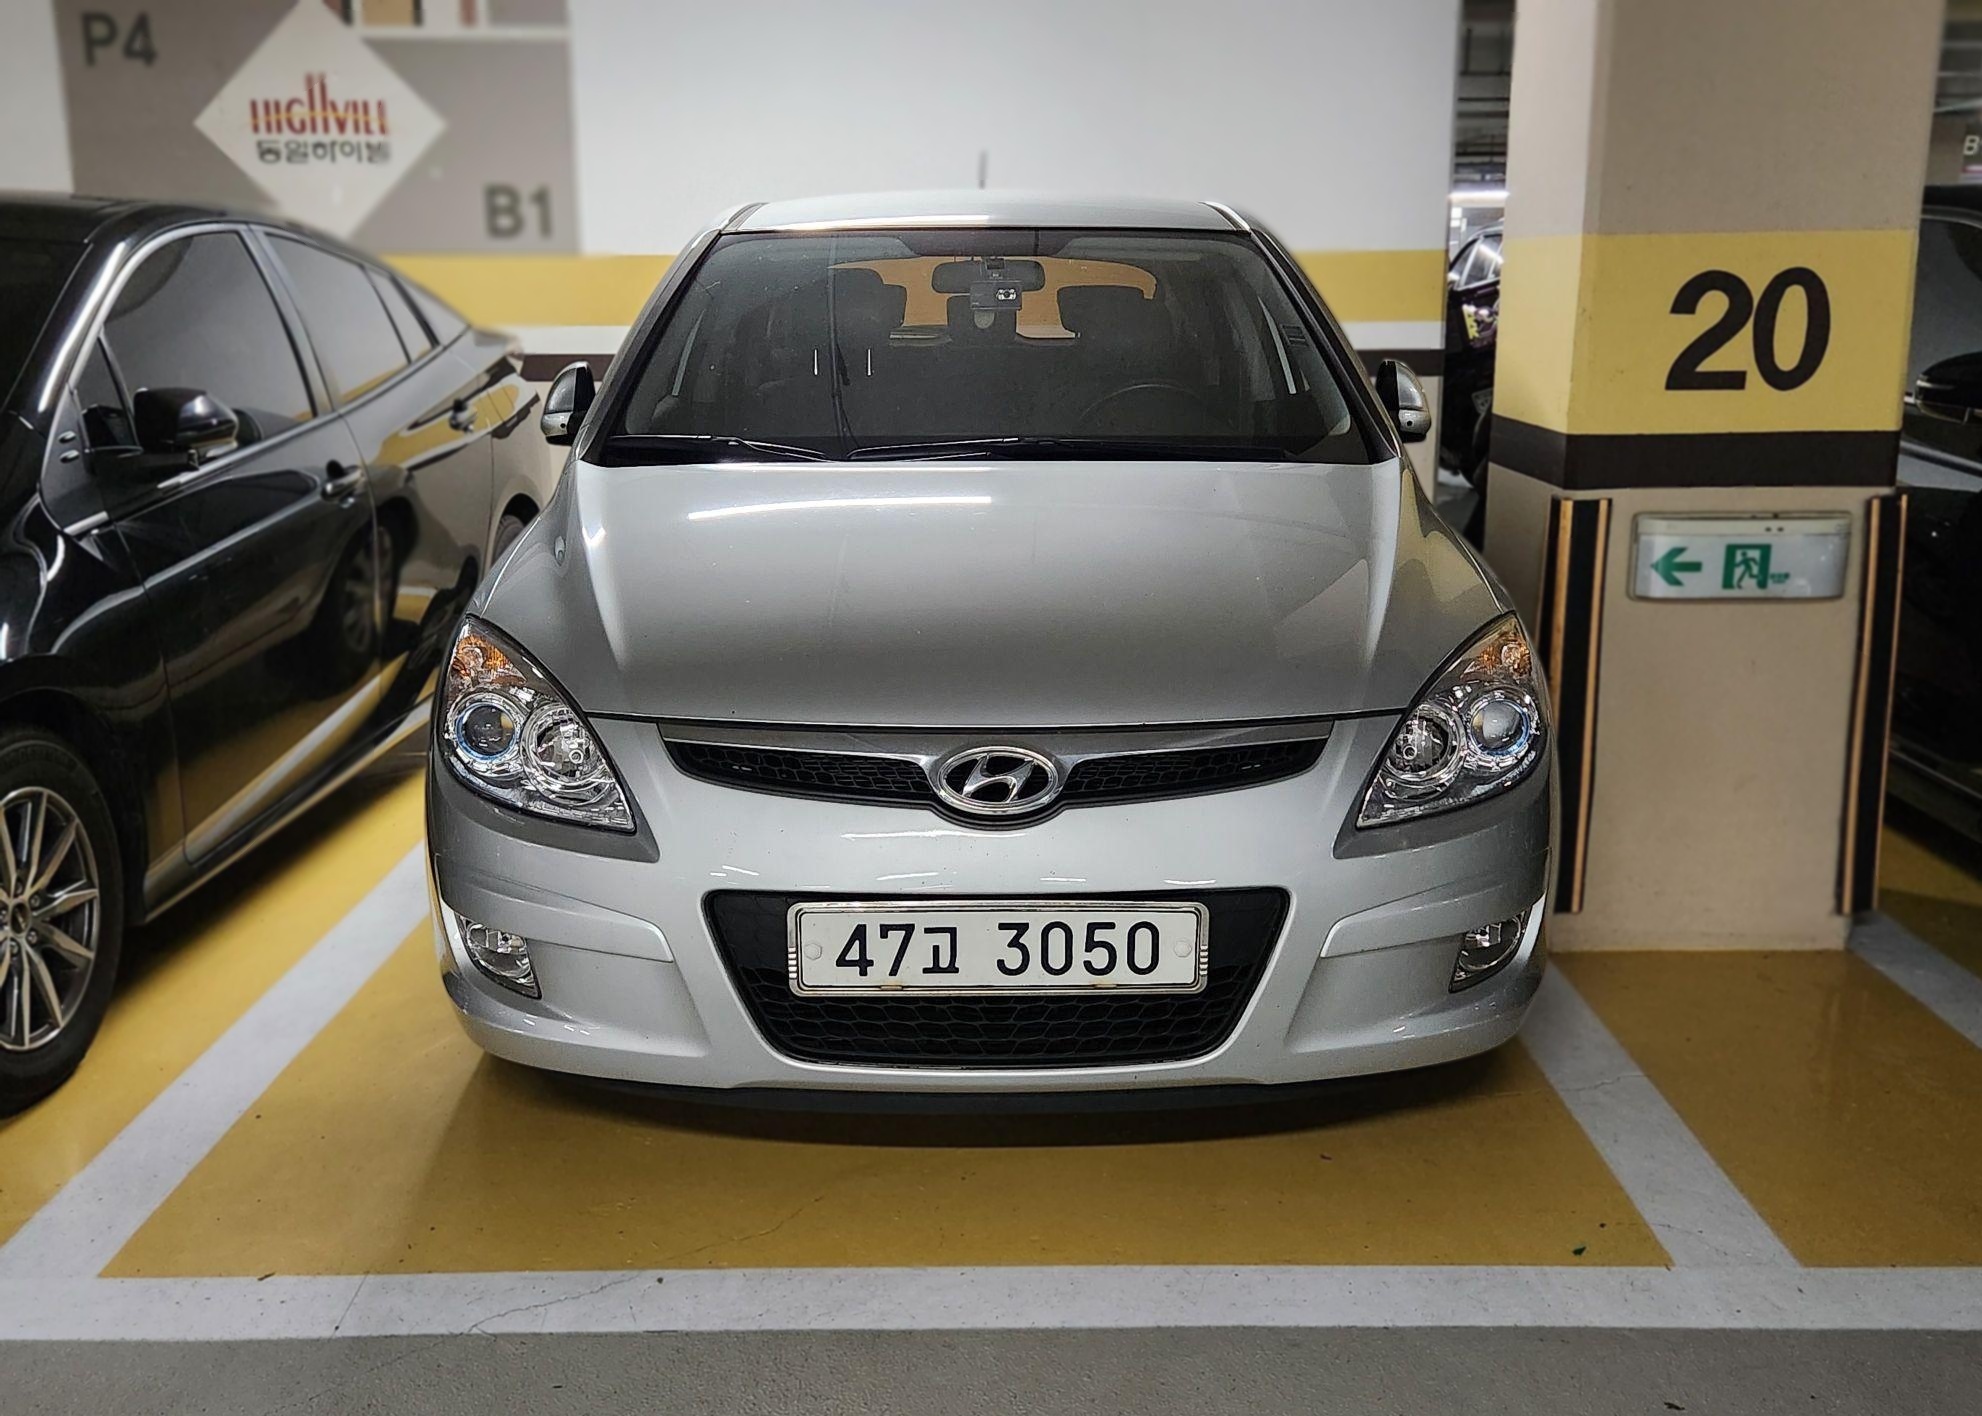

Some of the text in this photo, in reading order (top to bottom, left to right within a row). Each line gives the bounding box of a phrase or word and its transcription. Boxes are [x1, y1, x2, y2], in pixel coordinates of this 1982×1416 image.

[80, 11, 158, 67] P4
[484, 184, 552, 239] B1
[1665, 266, 1831, 391] 20
[835, 920, 1160, 977] 47고 3050
